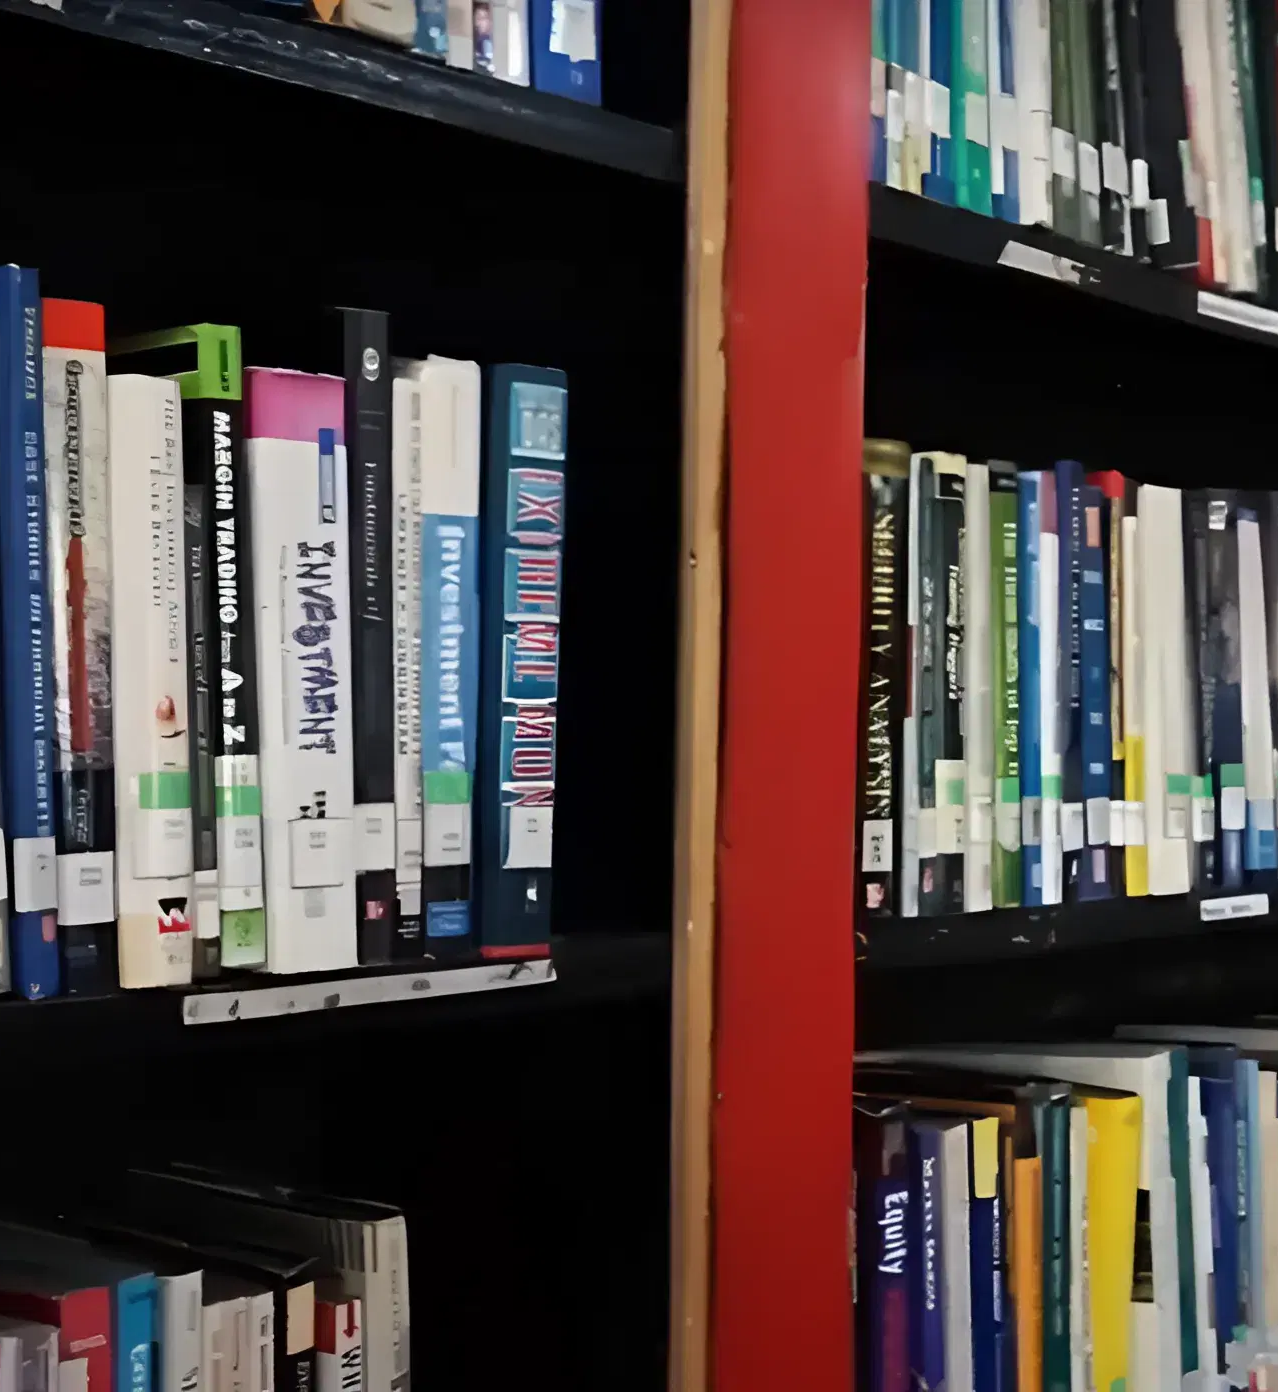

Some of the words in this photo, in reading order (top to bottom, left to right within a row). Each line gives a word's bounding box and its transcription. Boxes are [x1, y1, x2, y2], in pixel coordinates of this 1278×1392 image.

[212, 410, 234, 511] MARGIN
[216, 516, 239, 625] TRADING
[293, 539, 339, 754] INVESTMENT
[435, 525, 466, 730] Investment
[877, 1190, 909, 1275] Equity
